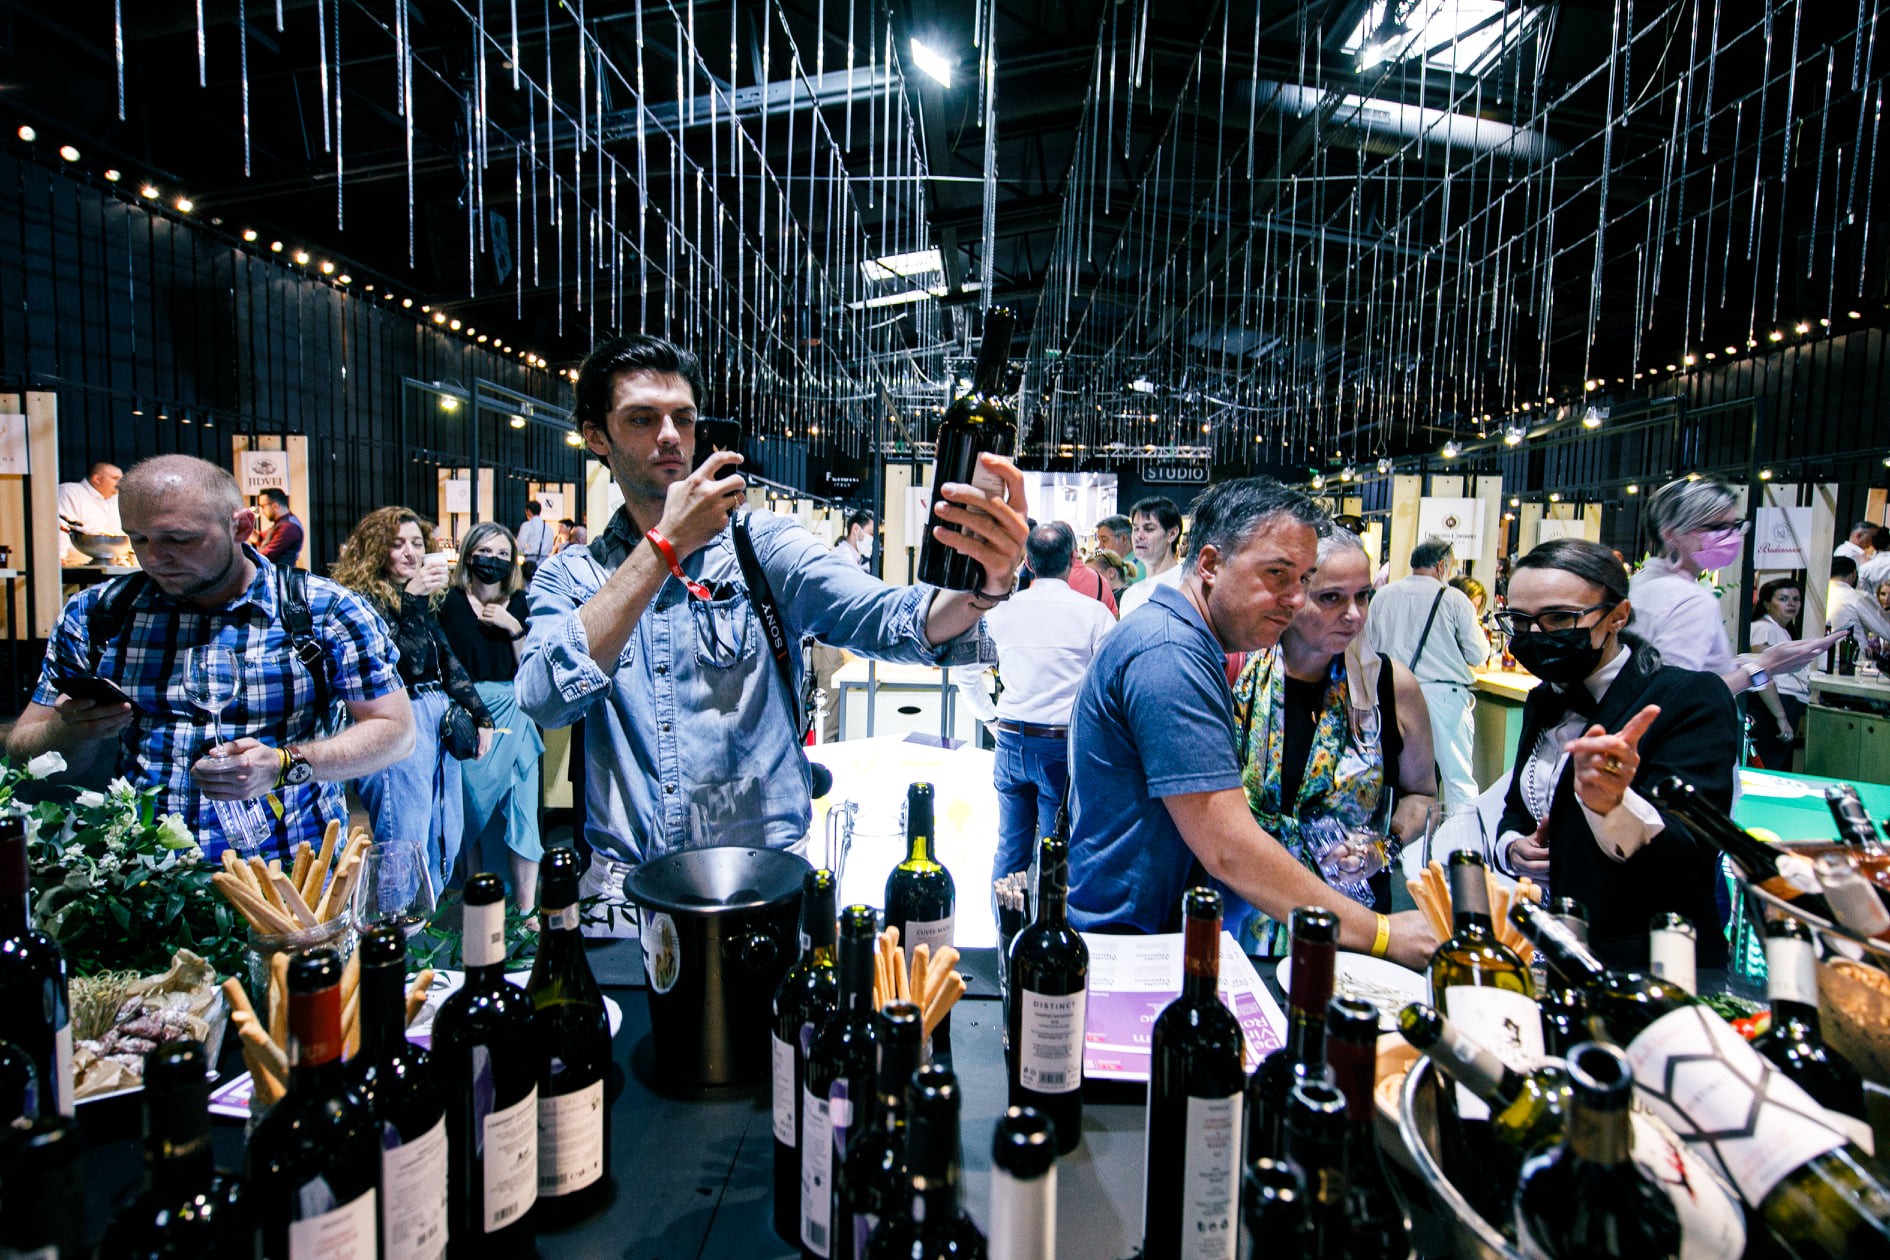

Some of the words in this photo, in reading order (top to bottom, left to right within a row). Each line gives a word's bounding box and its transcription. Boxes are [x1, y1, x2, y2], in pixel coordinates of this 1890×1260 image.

[1148, 467, 1204, 480] STUDIO
[761, 602, 783, 649] SONY
[1033, 1000, 1076, 1010] DISTINCT
